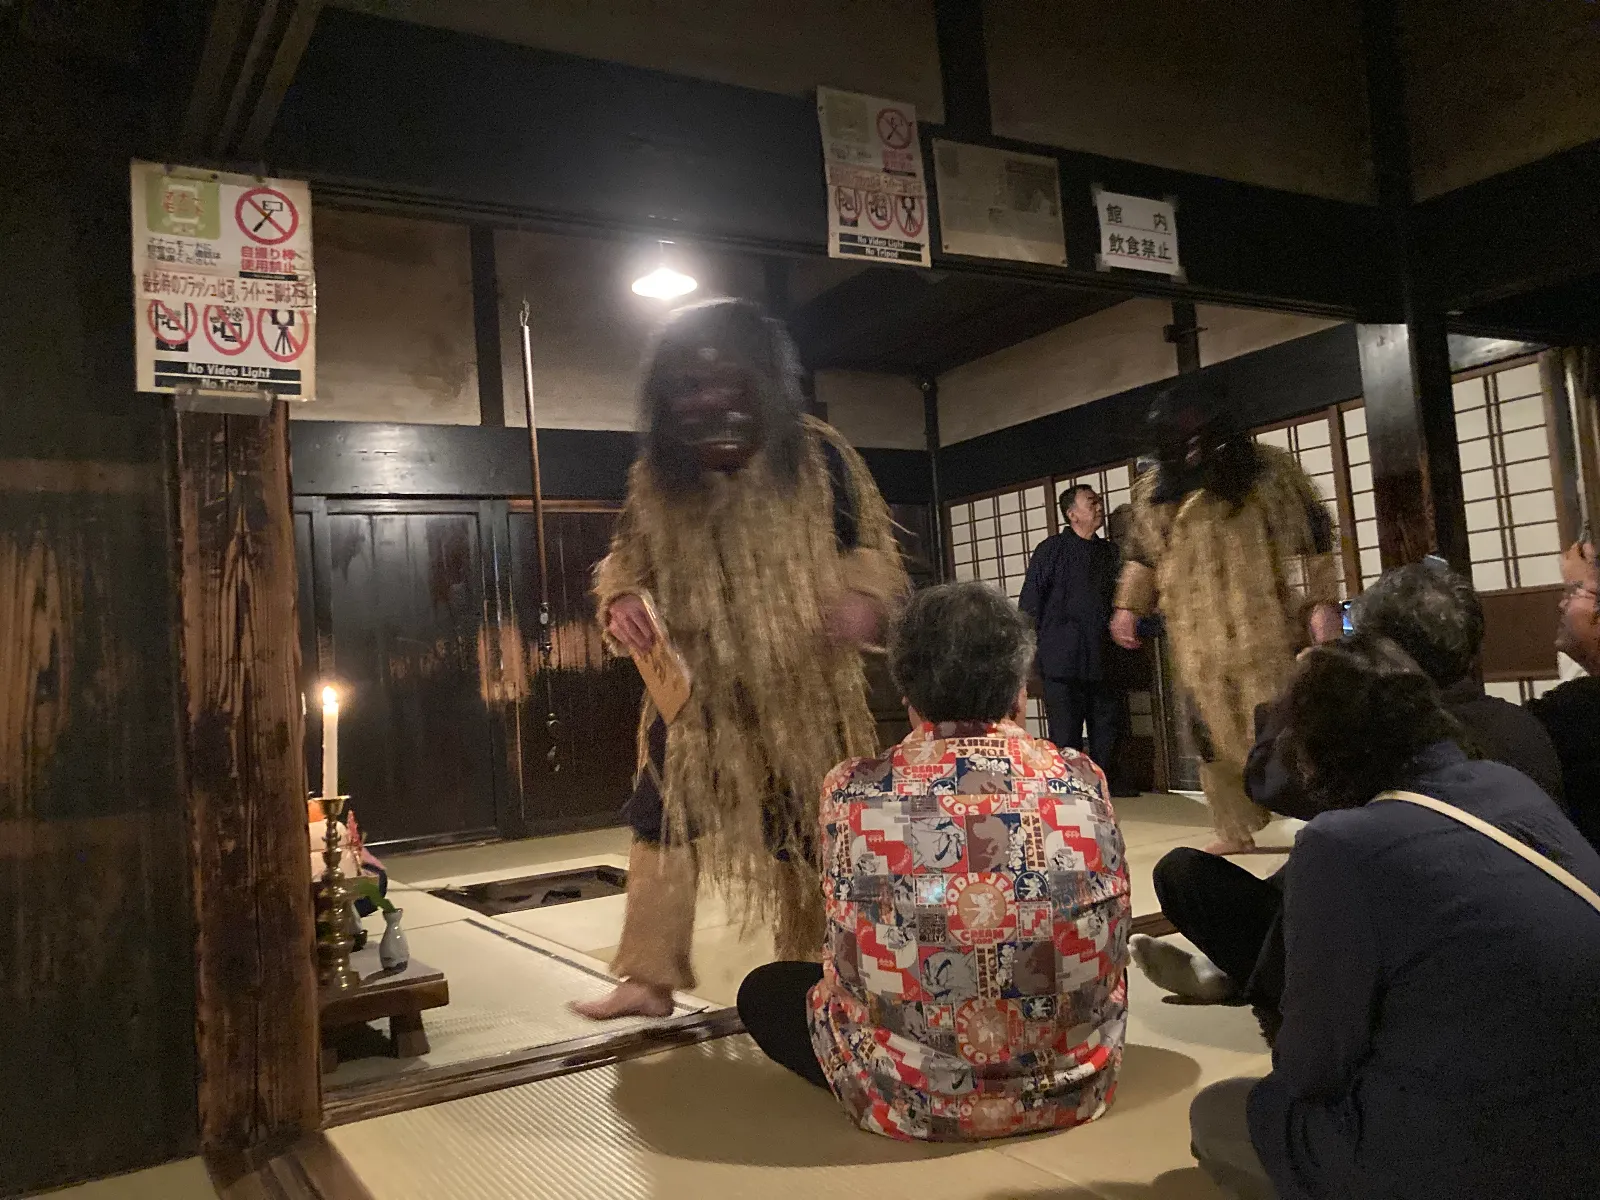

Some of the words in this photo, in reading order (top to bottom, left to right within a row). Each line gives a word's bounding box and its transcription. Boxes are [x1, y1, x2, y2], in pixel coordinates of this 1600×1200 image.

[857, 235, 867, 244] No
[868, 237, 887, 247] Video
[888, 239, 904, 248] Light
[1108, 232, 1172, 260] 飲食禁止
[865, 247, 875, 256] No
[187, 363, 204, 374] No
[207, 365, 238, 376] Video
[241, 366, 270, 378] Light
[902, 764, 943, 775] CREAM
[960, 928, 1005, 941] CREAM
